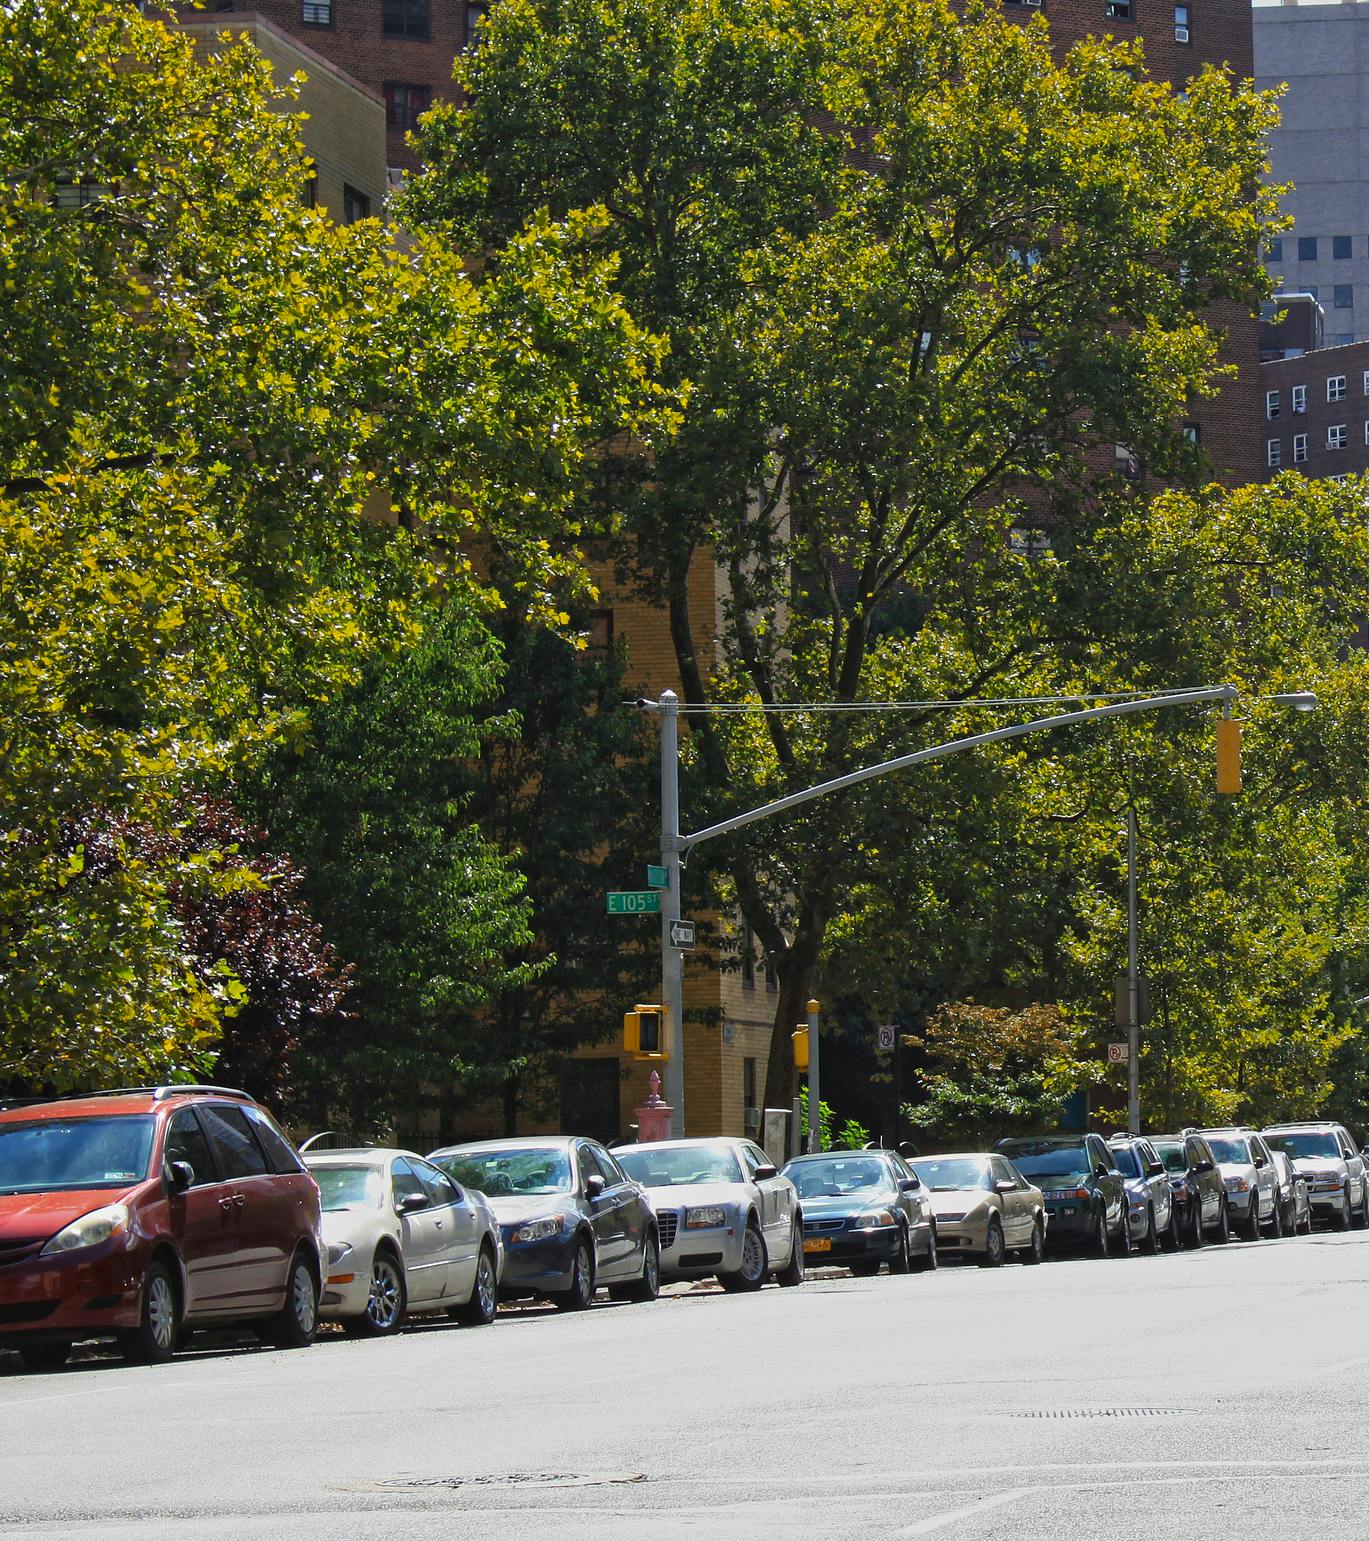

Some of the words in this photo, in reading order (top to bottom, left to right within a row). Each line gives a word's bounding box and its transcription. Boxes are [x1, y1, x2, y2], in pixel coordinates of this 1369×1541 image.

[609, 896, 616, 910] E
[622, 895, 646, 910] 105
[647, 895, 657, 903] ST
